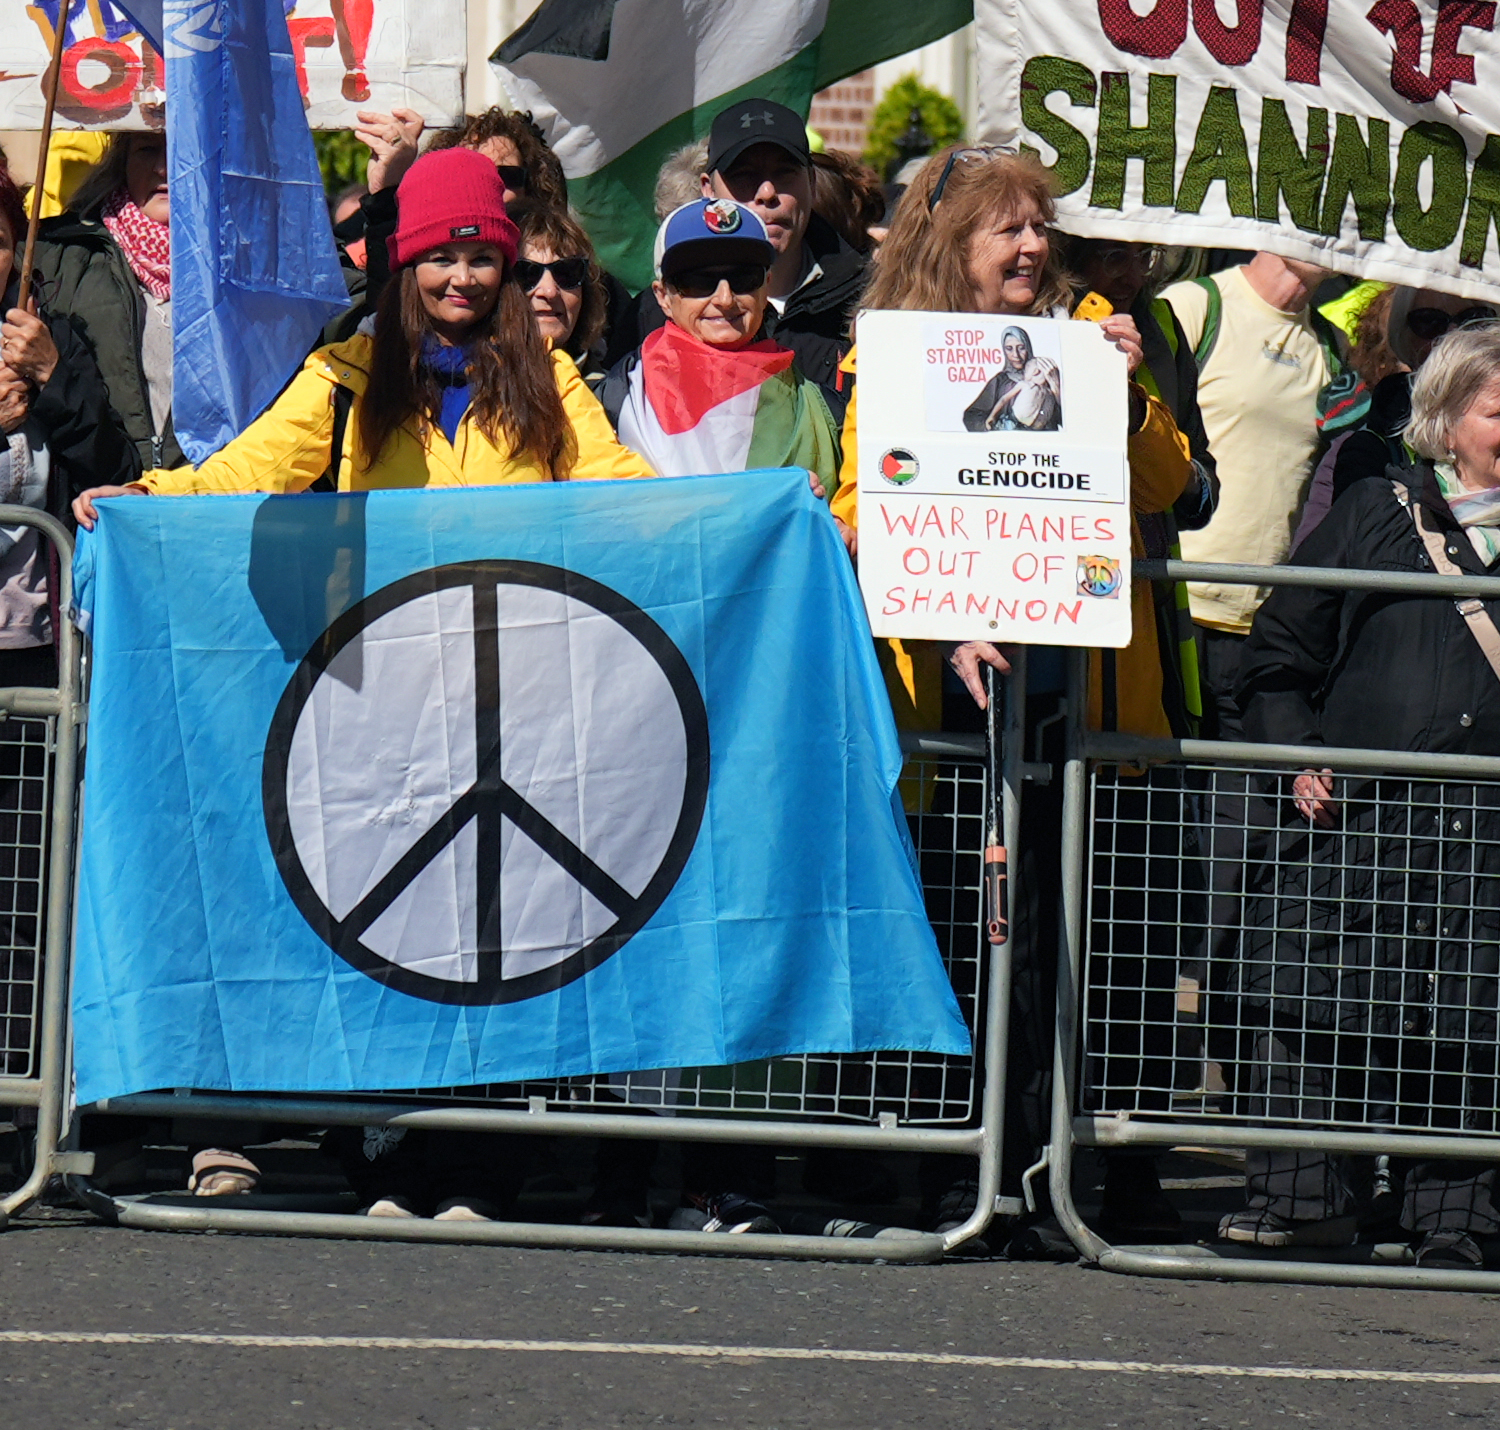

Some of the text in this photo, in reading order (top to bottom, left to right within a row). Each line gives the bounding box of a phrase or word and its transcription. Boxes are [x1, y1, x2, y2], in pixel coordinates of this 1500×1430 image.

[944, 330, 985, 346] STOP
[927, 348, 1002, 366] STARVING
[947, 367, 988, 383] GAZA
[988, 451, 1061, 468] STOP THE
[957, 468, 1092, 491] GENOCIDE
[879, 503, 1115, 543] WAR PLANES
[902, 547, 1065, 584] OUT OF
[881, 586, 1086, 625] SHANNON
